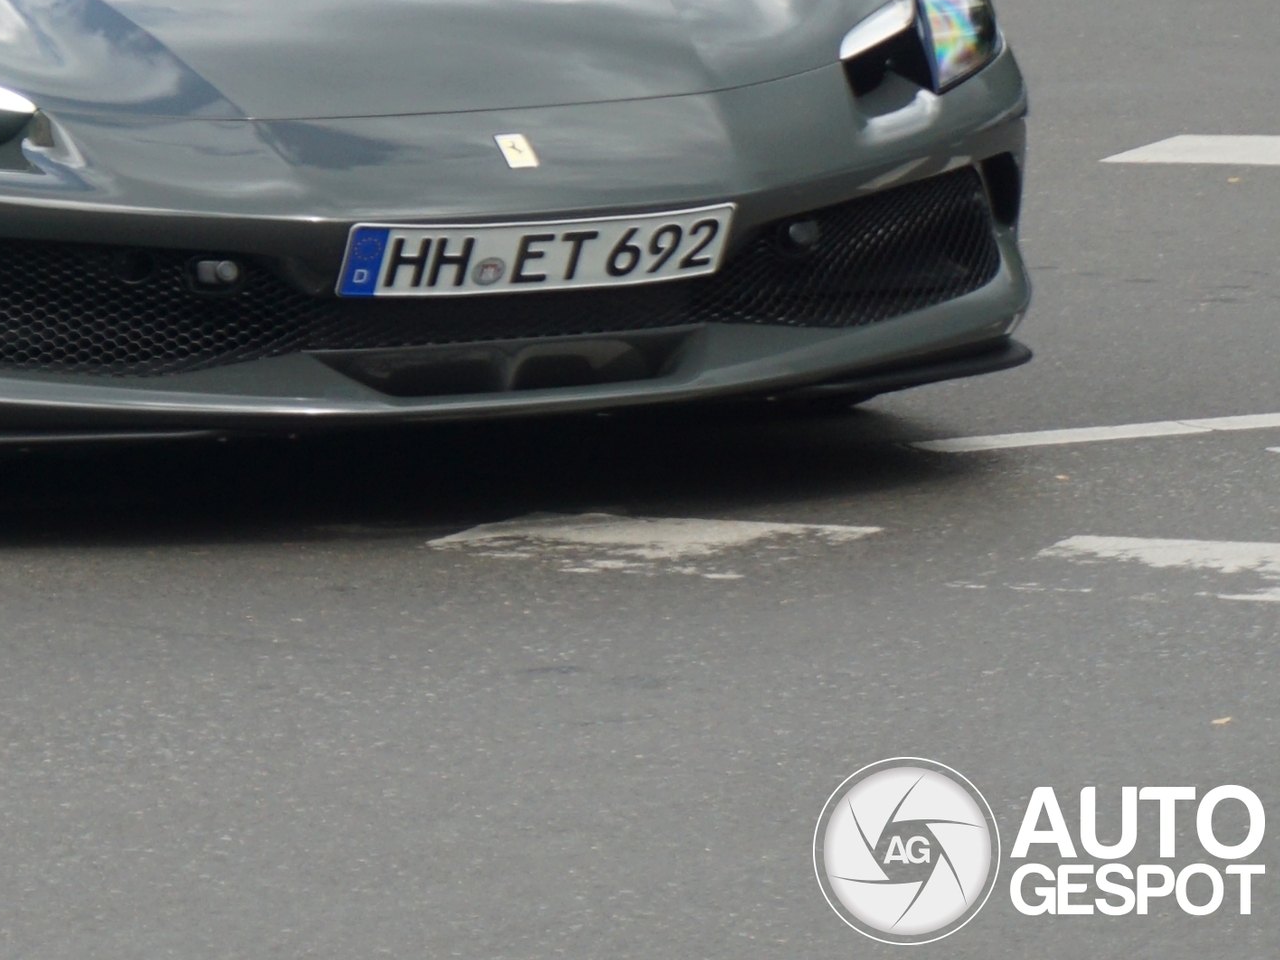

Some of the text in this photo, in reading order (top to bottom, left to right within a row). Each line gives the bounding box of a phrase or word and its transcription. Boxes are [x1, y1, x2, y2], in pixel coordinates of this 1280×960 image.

[383, 236, 476, 288] HH
[509, 230, 599, 284] ET
[606, 218, 720, 277] 692
